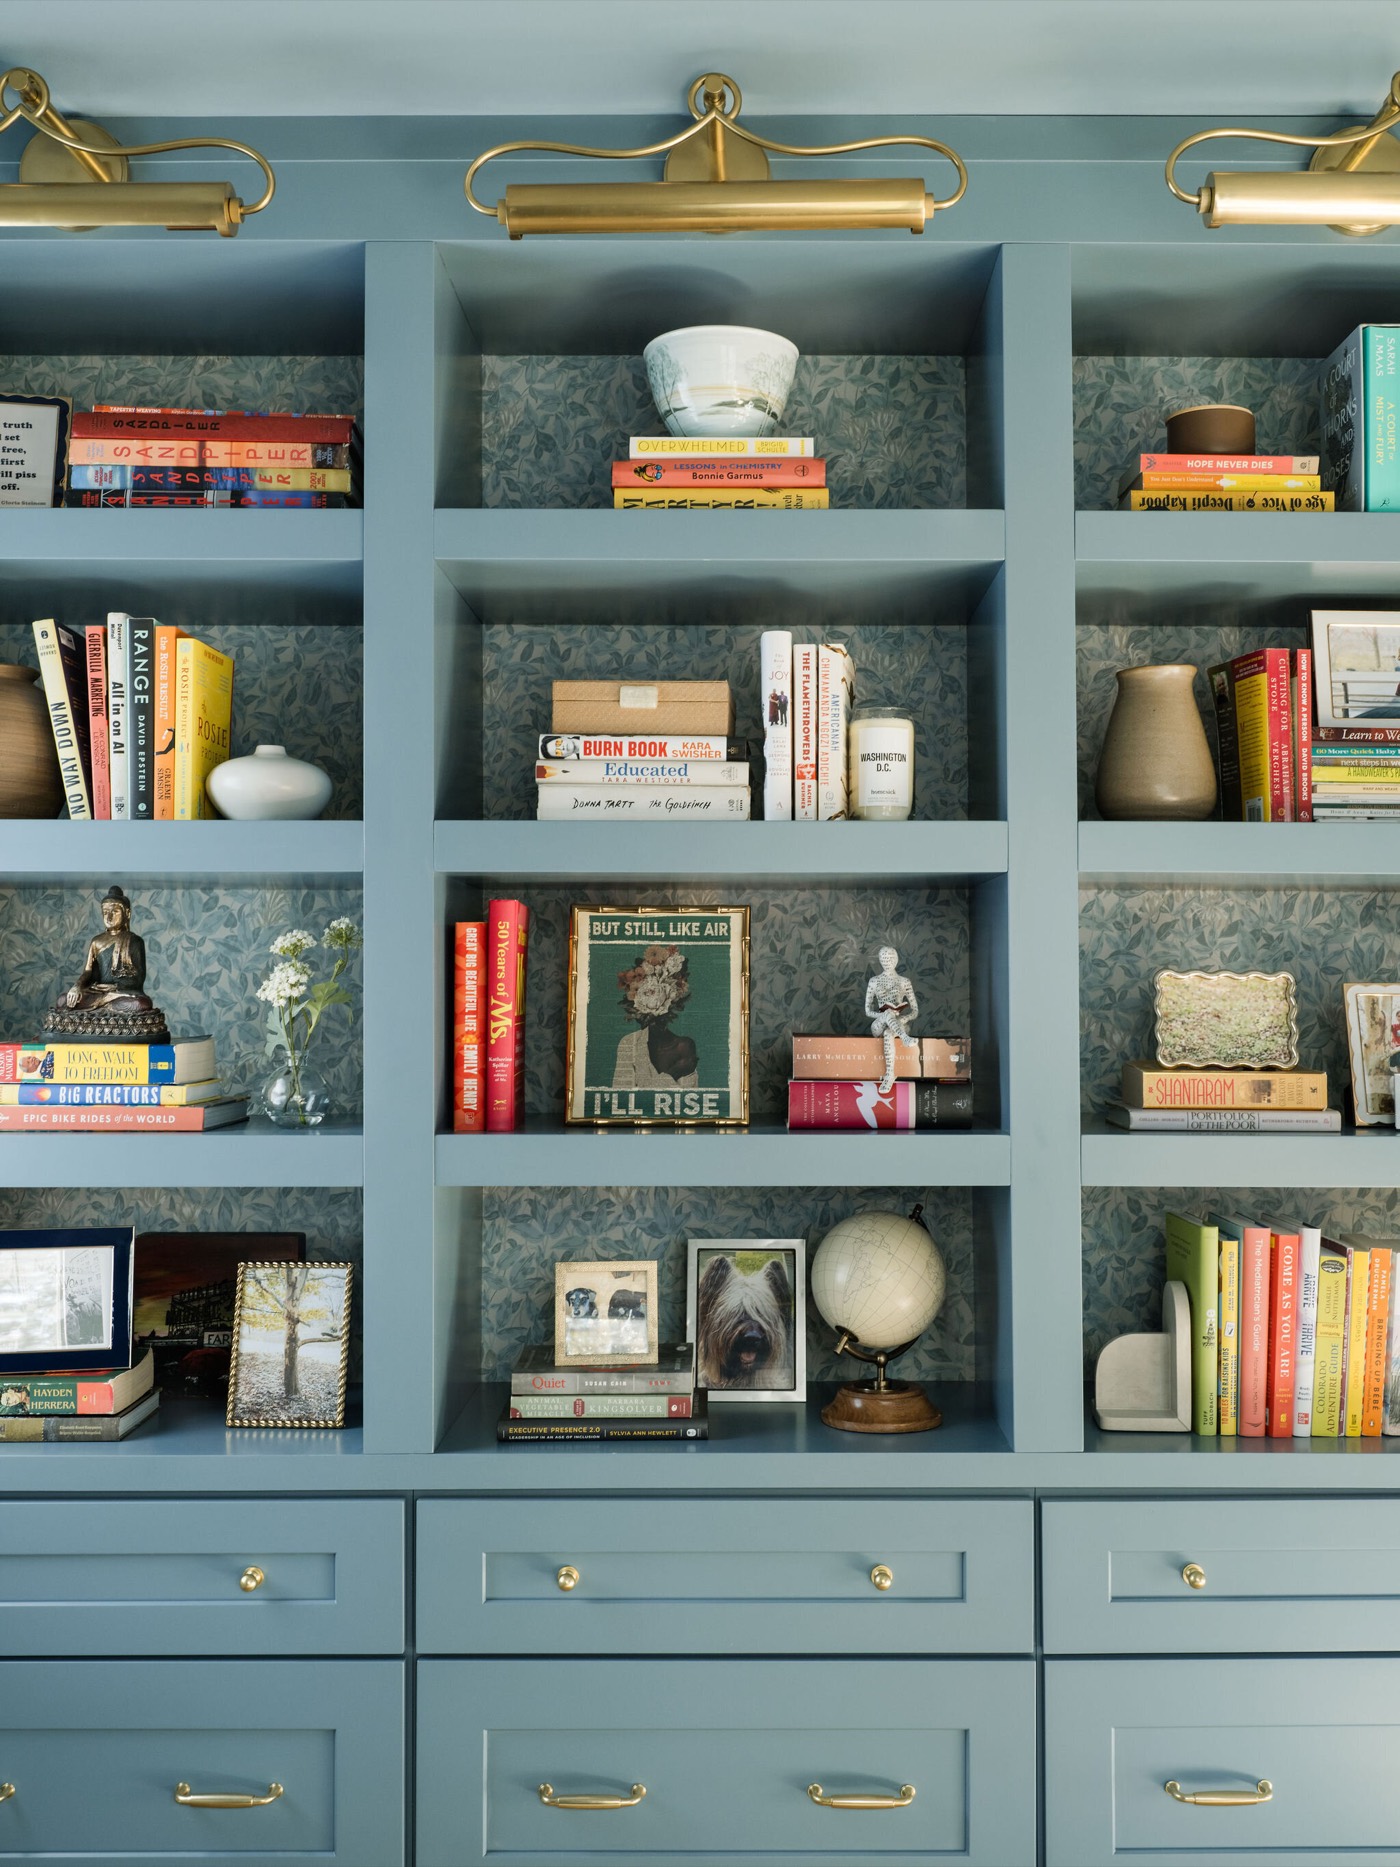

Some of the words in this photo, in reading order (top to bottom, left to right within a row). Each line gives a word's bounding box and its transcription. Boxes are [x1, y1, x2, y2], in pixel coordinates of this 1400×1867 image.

[1330, 348, 1357, 387] COURT
[1387, 338, 1395, 375] SARAH
[113, 420, 220, 430] SANDPIPER
[1323, 397, 1358, 441] THORNS
[2, 446, 26, 454] free,
[113, 446, 308, 463] SANDPIPER
[638, 441, 746, 452] OVERWHELMED
[1187, 460, 1214, 468] HOPE
[1216, 460, 1250, 469] NEVER
[1251, 460, 1273, 469] DIES
[132, 471, 291, 485] SANDPIPER
[692, 472, 724, 480] Bonnie
[727, 472, 764, 480] Garmus
[88, 632, 102, 673] GUERRILLA
[134, 630, 150, 704] RANGE
[769, 670, 789, 680] JOY
[1302, 672, 1308, 680] TO
[112, 682, 124, 698] All
[820, 658, 830, 717] CHIMAMANDA
[1279, 658, 1288, 706] CUTTING
[90, 677, 104, 718] MARKETING
[112, 703, 124, 716] in
[802, 674, 810, 761] FLAMETHROWERS
[1280, 710, 1288, 731] FOR
[51, 702, 74, 750] DOWN
[112, 720, 124, 736] on
[197, 716, 228, 748] ROSIE
[831, 694, 840, 752] AMERICANAH
[682, 742, 711, 750] KARA
[820, 721, 830, 749] NGOZI
[113, 742, 124, 754] AI
[583, 740, 623, 758] BURN
[628, 741, 668, 758] BOOK
[672, 750, 722, 758] SWISHER
[860, 753, 906, 763] WASHINGTON
[61, 757, 80, 791] WAY
[604, 762, 688, 777] Educated
[820, 751, 830, 786] ADICHIE
[876, 763, 892, 772] D.C.
[1272, 742, 1280, 796] VERGHESE
[1281, 744, 1290, 793] ABRAHAM
[69, 793, 86, 815] NO
[573, 798, 600, 810] DONNA
[604, 800, 634, 810] TARTT
[466, 928, 477, 952] GREAT
[497, 920, 510, 938] 50
[592, 922, 620, 936] BUT
[624, 922, 666, 938] STILL,
[669, 922, 700, 936] LIKE
[704, 922, 728, 936] AIR
[466, 954, 477, 968] BIG
[496, 941, 510, 979] Years
[464, 970, 477, 1013] BEAUTIFUL
[498, 982, 510, 998] of
[464, 1014, 477, 1032] LIFE
[490, 996, 512, 1044] Ms.
[67, 1051, 98, 1064] LONG
[103, 1051, 135, 1064] WALK
[464, 1044, 478, 1075] EMILY
[64, 1067, 78, 1080] TO
[83, 1067, 138, 1080] FREEDOM
[464, 1078, 478, 1111] HENRY
[1156, 1078, 1234, 1105] SHANTARAM
[594, 1093, 643, 1115] I'LL
[654, 1093, 720, 1116] RISE
[24, 1114, 48, 1122] EPIC
[52, 1114, 76, 1122] BIKE
[80, 1114, 111, 1123] RIDES
[114, 1114, 122, 1122] of
[122, 1114, 134, 1122] the
[136, 1114, 176, 1123] WORLD
[1190, 1112, 1256, 1121] PORTFOLIOS
[1254, 1240, 1263, 1257] The
[1283, 1245, 1293, 1286] COME
[1252, 1259, 1262, 1322] Mediatrician's
[1282, 1290, 1292, 1309] AS
[1302, 1274, 1316, 1308] ARRIVE
[1252, 1324, 1261, 1352] Guide
[1281, 1314, 1291, 1344] YOU
[1300, 1322, 1314, 1356] THRIVE
[1376, 1318, 1384, 1367] BRINGING
[1280, 1348, 1290, 1378] ARE
[1329, 1342, 1339, 1374] GUIDE
[532, 1376, 566, 1389] Quiet
[1316, 1360, 1326, 1414] COLORADO
[1375, 1370, 1382, 1384] UP
[34, 1388, 73, 1396] HAYDEN
[1372, 1386, 1381, 1411] BÉBÉ
[30, 1400, 76, 1410] HERRERA
[589, 1405, 662, 1413] KINGSOLVER
[1326, 1374, 1338, 1434] ADVENTURE
